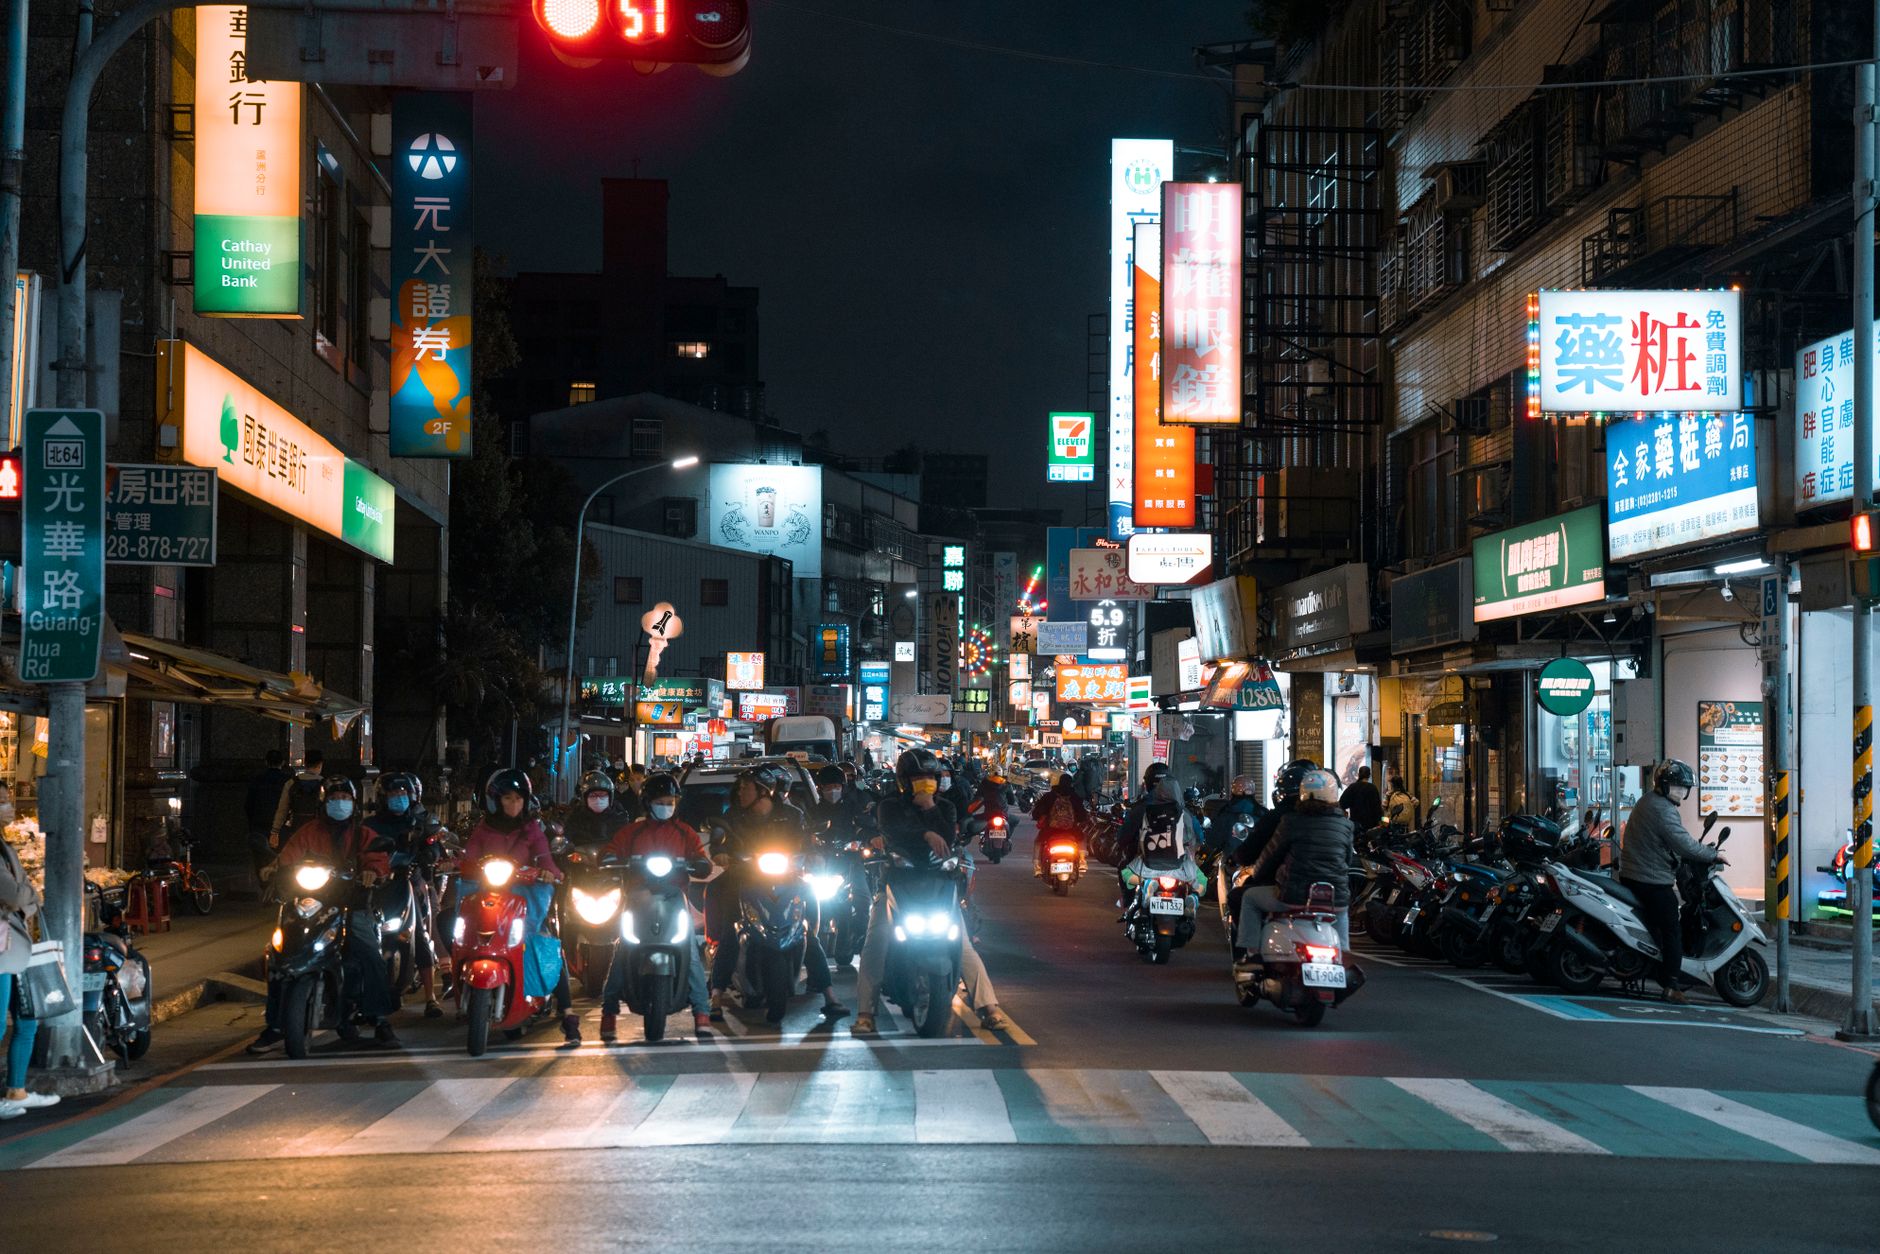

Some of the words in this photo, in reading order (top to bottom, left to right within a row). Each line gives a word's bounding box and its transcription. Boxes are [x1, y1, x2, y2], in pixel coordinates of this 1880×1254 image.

[221, 239, 271, 256] Cathay
[221, 256, 271, 271] United
[221, 275, 258, 288] Bank
[412, 197, 452, 361] 元大證券
[1555, 311, 1702, 396] 藥粧
[1705, 309, 1728, 397] 免費調劑
[1820, 344, 1835, 495] 身心官能症
[1838, 337, 1854, 490] 焦慮症
[432, 422, 452, 435] 2F
[1802, 350, 1817, 500] 肥胖症
[1057, 437, 1086, 446] ELEVEN
[1613, 411, 1749, 488] 全家藥粧藥局
[49, 447, 80, 463] 北64
[243, 413, 309, 496] 國泰世華銀行
[1729, 463, 1749, 482] 光華店
[105, 469, 211, 506] 房出租
[1144, 499, 1186, 509] 國際服務
[42, 472, 86, 610] 光華路
[29, 611, 97, 636] Guang-
[1090, 608, 1124, 626] 5.9
[1097, 627, 1117, 646] 折
[27, 639, 61, 657] hua
[25, 659, 54, 678] Rd.
